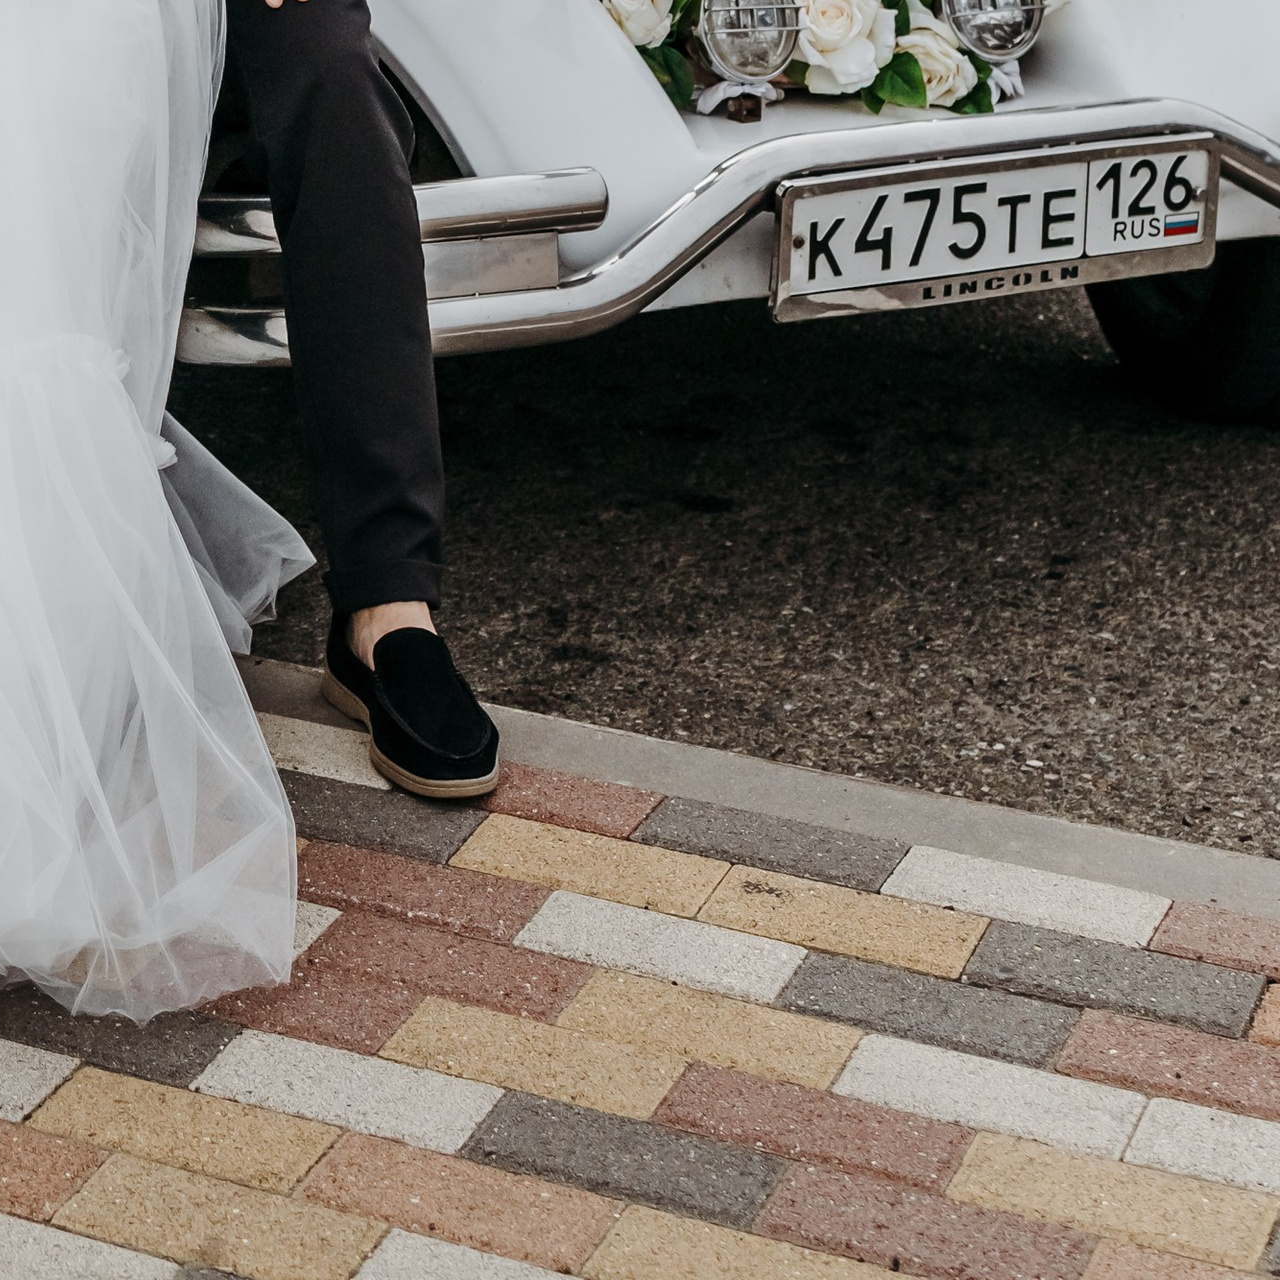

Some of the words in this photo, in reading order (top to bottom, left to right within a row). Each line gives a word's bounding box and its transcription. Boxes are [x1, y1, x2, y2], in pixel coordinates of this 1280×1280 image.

[1095, 154, 1193, 220] 126
[1113, 217, 1161, 242] RUS
[922, 265, 1079, 300] LINCOLN
